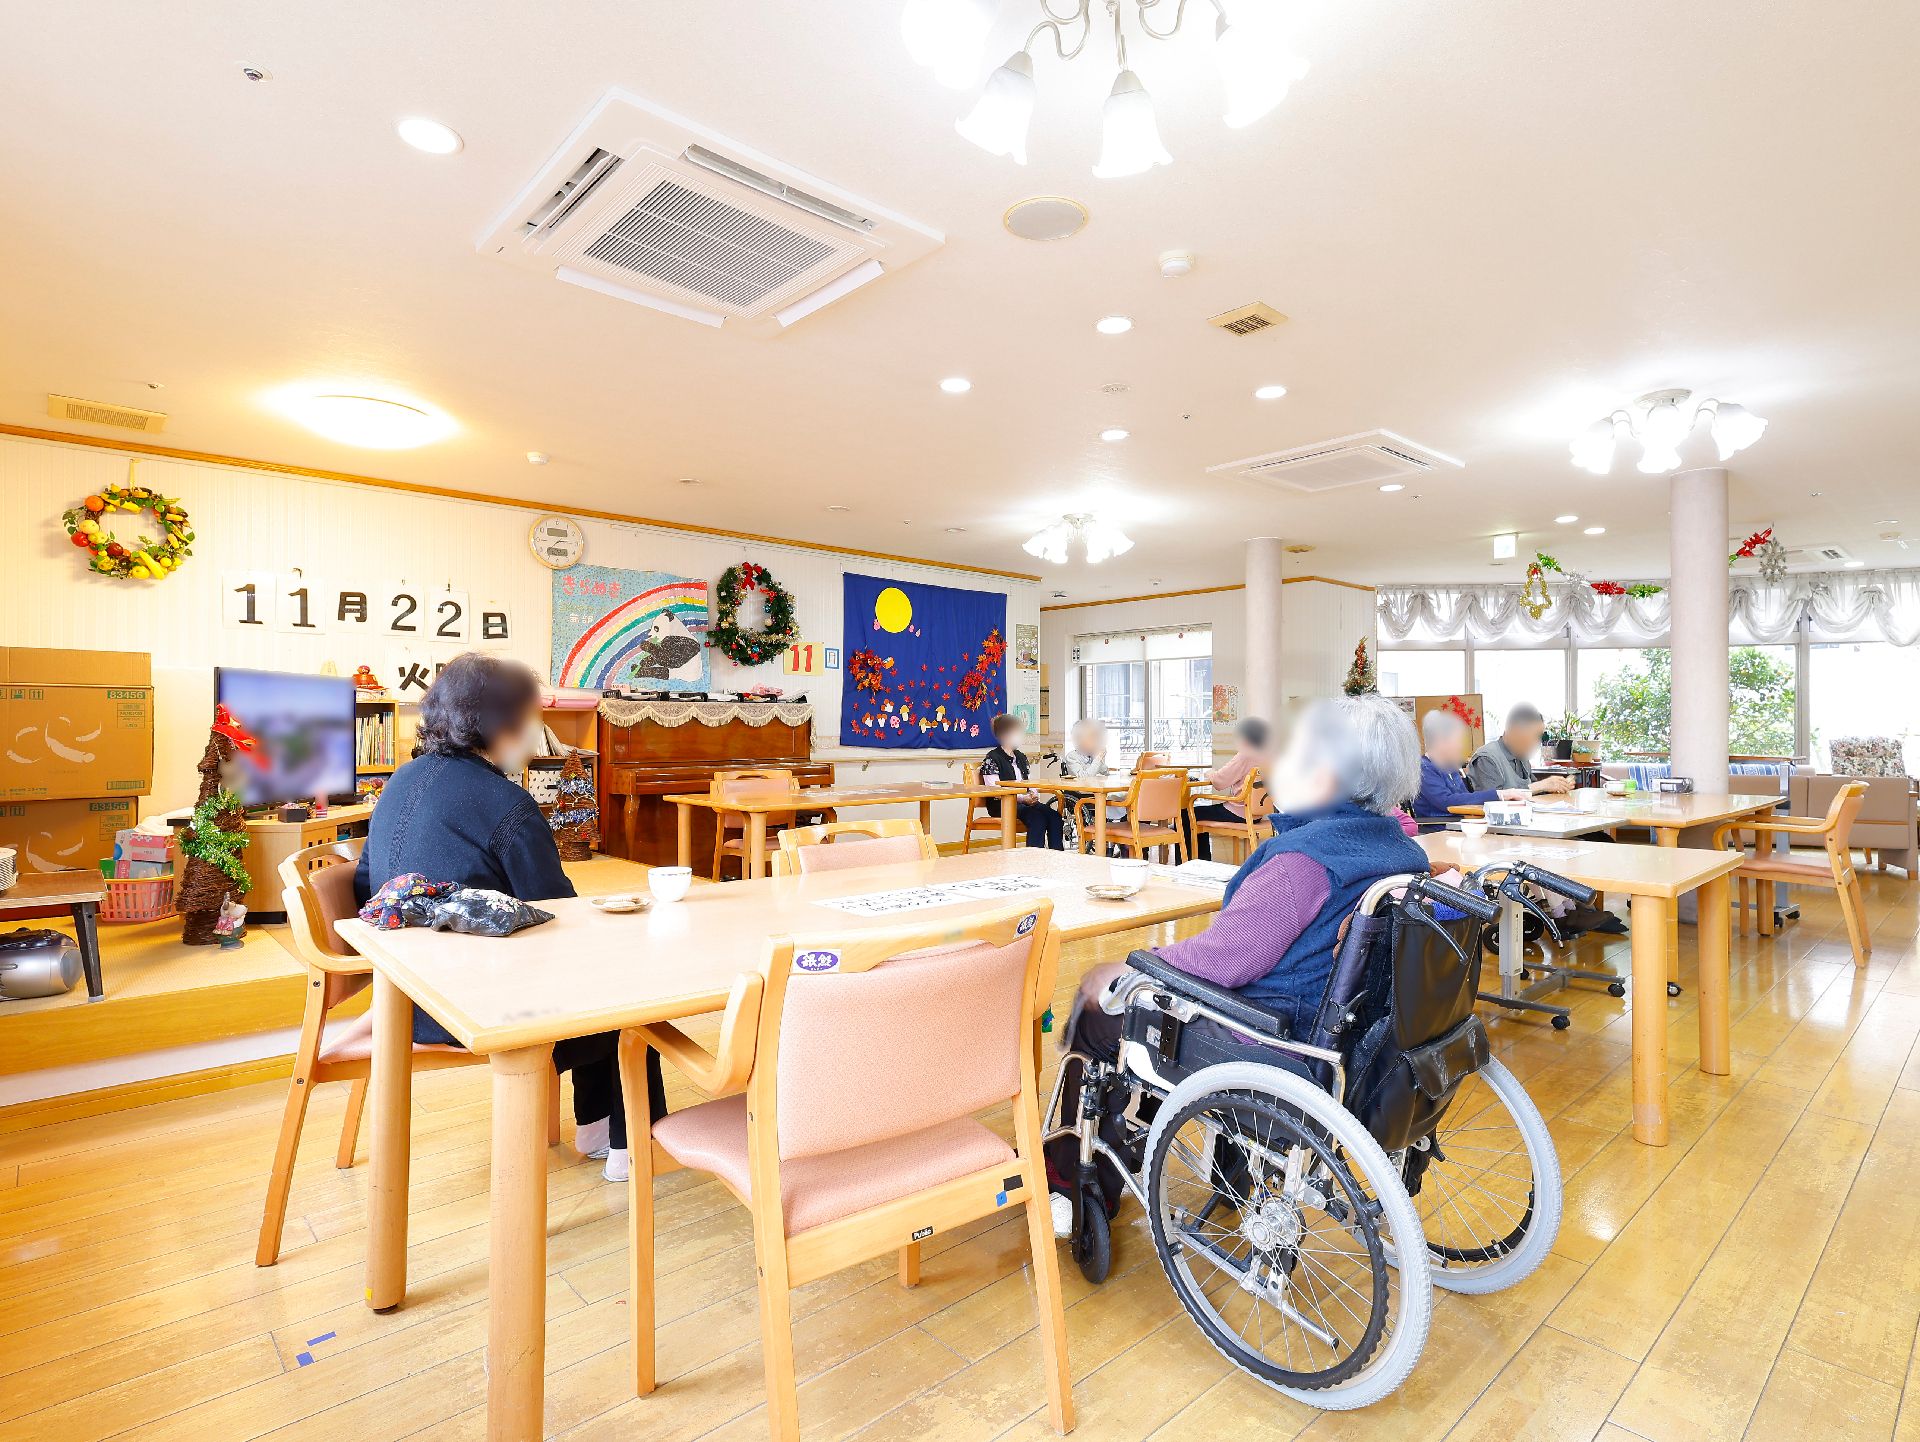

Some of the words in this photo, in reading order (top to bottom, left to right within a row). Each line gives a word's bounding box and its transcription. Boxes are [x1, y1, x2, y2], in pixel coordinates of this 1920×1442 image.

[562, 575, 621, 598] きらめき
[234, 583, 508, 639] 11月22日
[790, 645, 812, 672] 11
[110, 691, 143, 699] 83456
